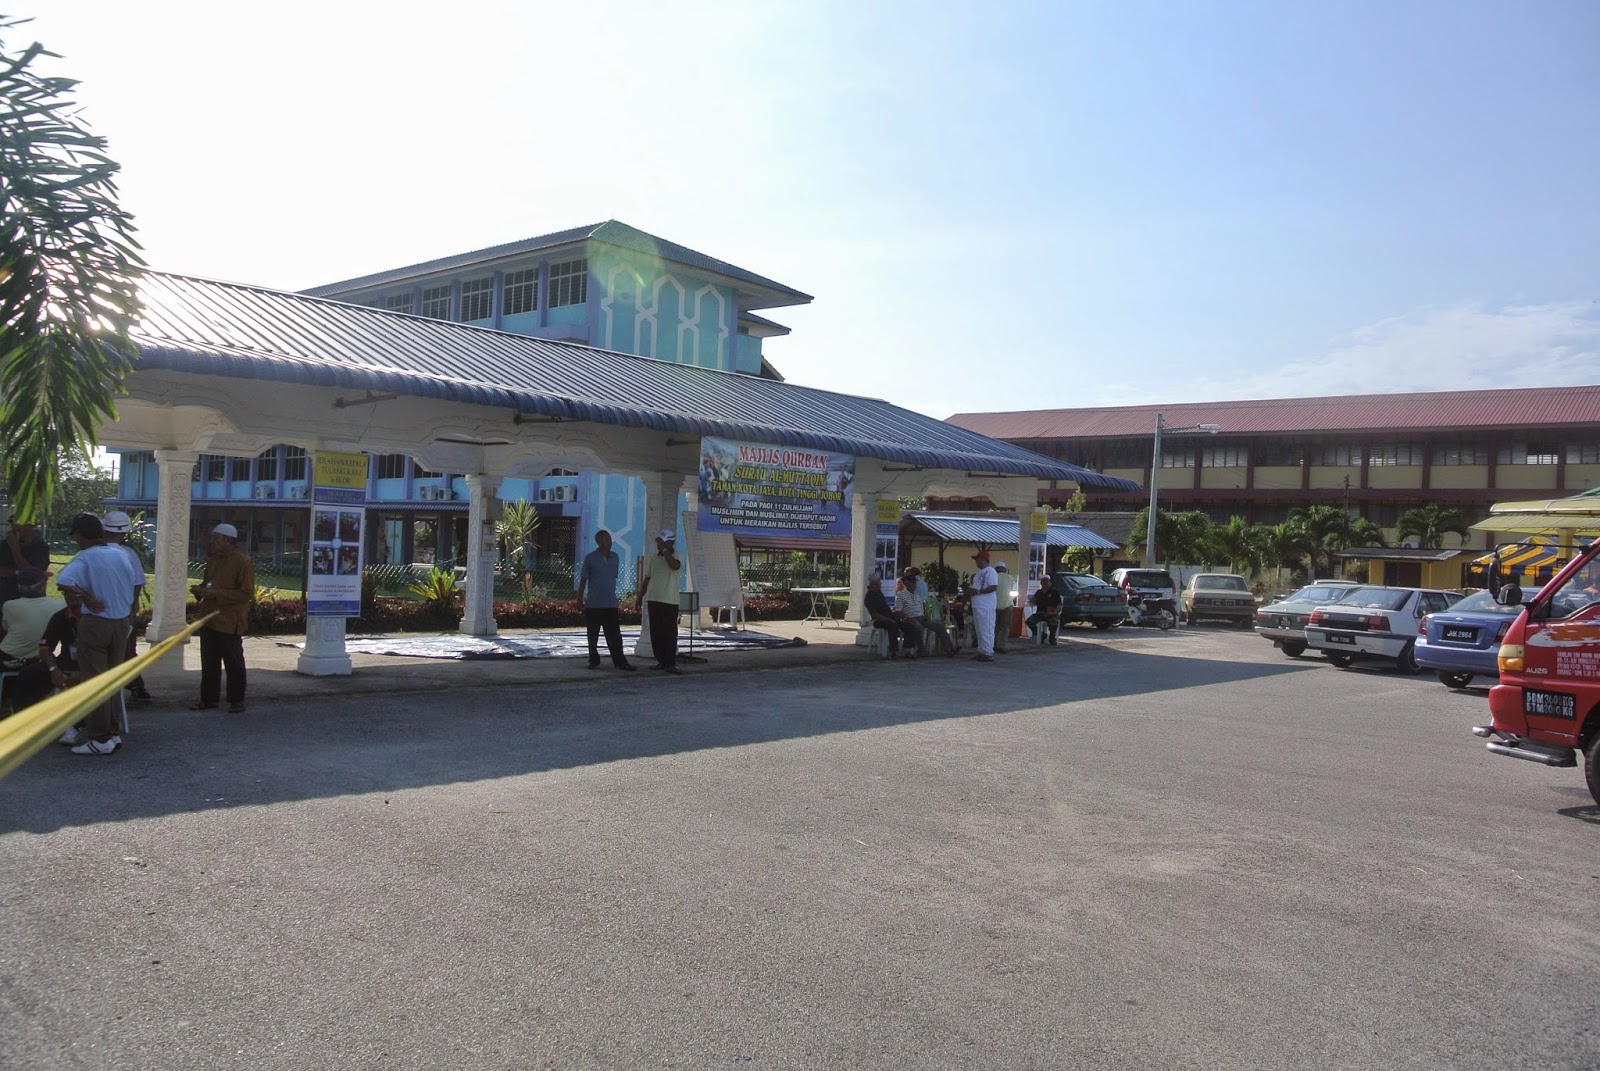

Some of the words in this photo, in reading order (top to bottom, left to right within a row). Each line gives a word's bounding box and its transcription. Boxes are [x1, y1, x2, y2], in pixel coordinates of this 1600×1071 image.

[739, 446, 779, 465] MAJLIS
[782, 450, 827, 469] QURBAN
[735, 466, 766, 480] SURAU
[770, 469, 826, 487] AL-MUTTAQIN
[712, 481, 736, 492] TAMAN
[738, 483, 757, 495] KOTA
[779, 487, 795, 498] KOTA
[797, 488, 818, 499] TINGGI
[820, 491, 842, 501] JOHOR
[741, 500, 758, 509] PADA
[759, 502, 773, 510] PAGI
[782, 504, 813, 512] ZULHIJJAH
[711, 507, 744, 516] MUSLIMIN
[745, 510, 759, 519] DAN
[759, 511, 789, 520] MUSLIMAT
[790, 513, 818, 521] DIJEMPUT
[720, 517, 743, 526] UNTUK
[744, 519, 777, 528] MERAIKAN
[777, 521, 798, 529] MAJLIS
[799, 522, 828, 530] TERSEBUT
[1562, 695, 1574, 708] KG
[1562, 706, 1574, 718] KG
